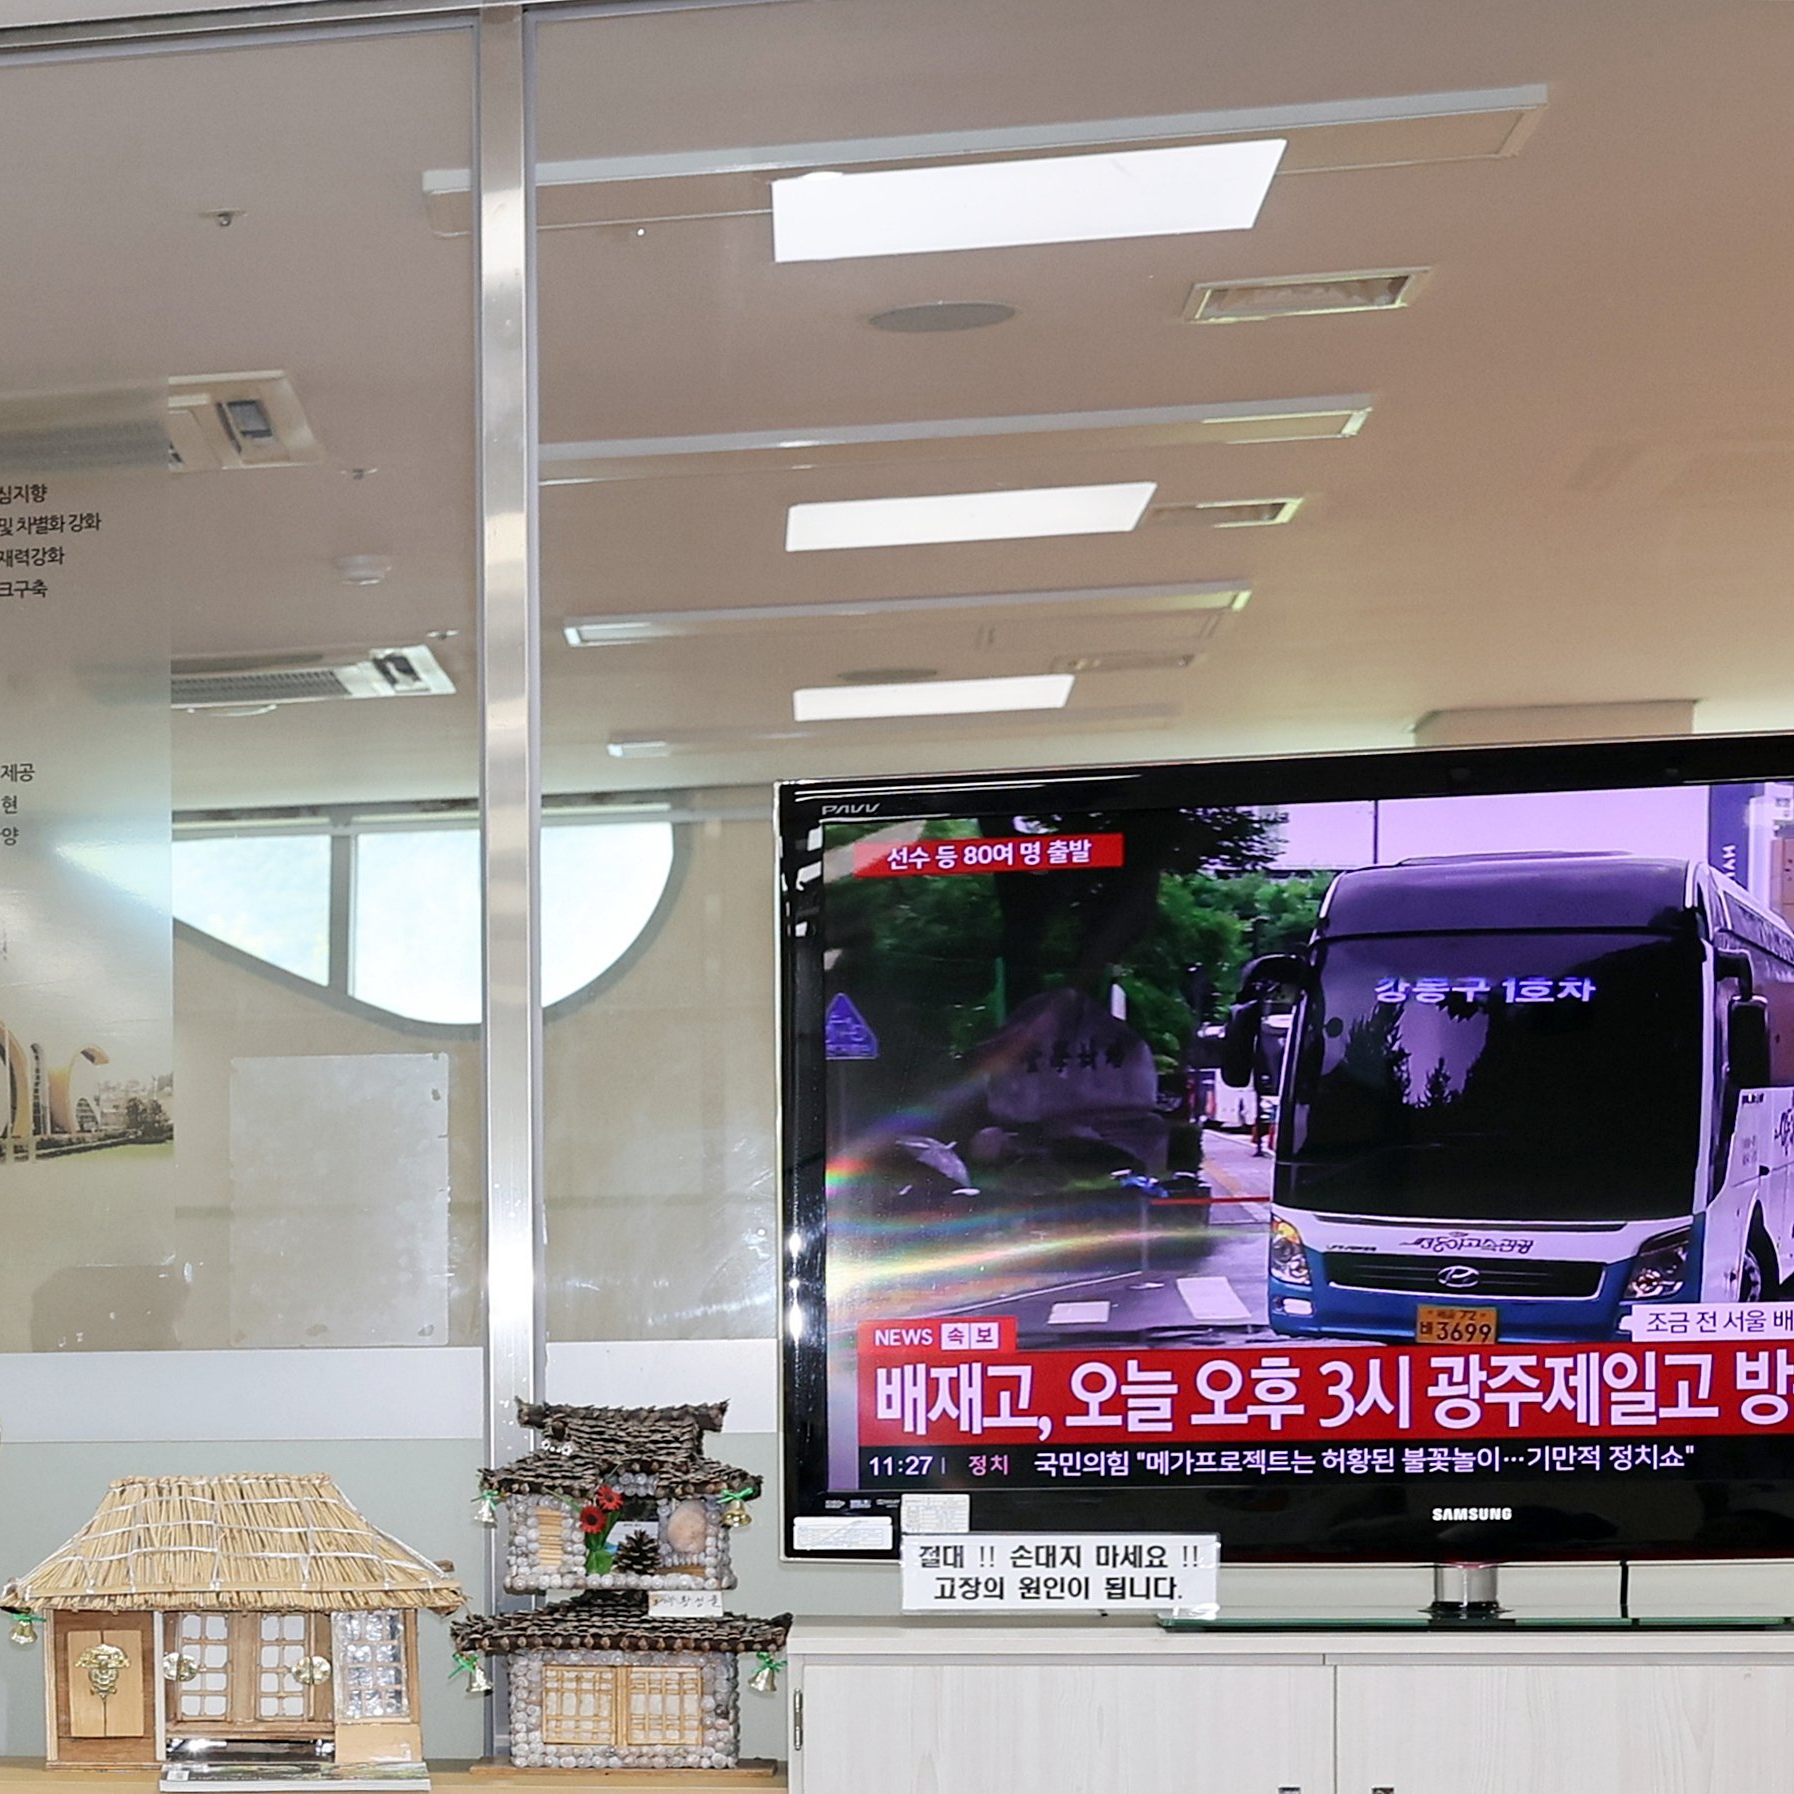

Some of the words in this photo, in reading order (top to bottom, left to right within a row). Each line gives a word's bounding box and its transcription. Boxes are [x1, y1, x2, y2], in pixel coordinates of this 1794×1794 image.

[16, 514, 65, 535] 차별화
[69, 512, 101, 532] 강화
[0, 763, 35, 782] 제공
[887, 846, 930, 870] 선수
[935, 845, 958, 869] 등
[964, 842, 1013, 866] 80여
[1020, 841, 1040, 865] 명
[1047, 840, 1091, 864] 출발
[1502, 977, 1597, 1003] 1호차
[1437, 1321, 1491, 1343] 3699
[1647, 1311, 1690, 1334] 조금
[1696, 1310, 1718, 1333] 전
[1723, 1310, 1767, 1332] 서울
[1774, 1309, 1794, 1331] 배
[875, 1329, 933, 1347] NEWS
[877, 1362, 1053, 1442] 배재고,
[1065, 1360, 1178, 1432] 오늘
[1191, 1357, 1304, 1430] 오후
[1319, 1355, 1410, 1429] 3시
[1427, 1351, 1719, 1429] 광주제일고
[870, 1456, 932, 1477] 11:27
[968, 1455, 1008, 1476] 정치
[1034, 1452, 1129, 1476] 국민의힘
[1137, 1451, 1315, 1476] "메가프로젝트는
[1322, 1446, 1395, 1473] 허황된
[1609, 1444, 1694, 1471] 정치쇼"
[1433, 1507, 1512, 1521] SAMSUNG
[919, 1545, 963, 1568] 절대
[1010, 1545, 1081, 1568] 손대지
[1097, 1545, 1167, 1568] 마세요
[935, 1577, 1003, 1600] 고장의
[1019, 1577, 1089, 1600] 원인이
[1105, 1576, 1183, 1600] 됩니다.
